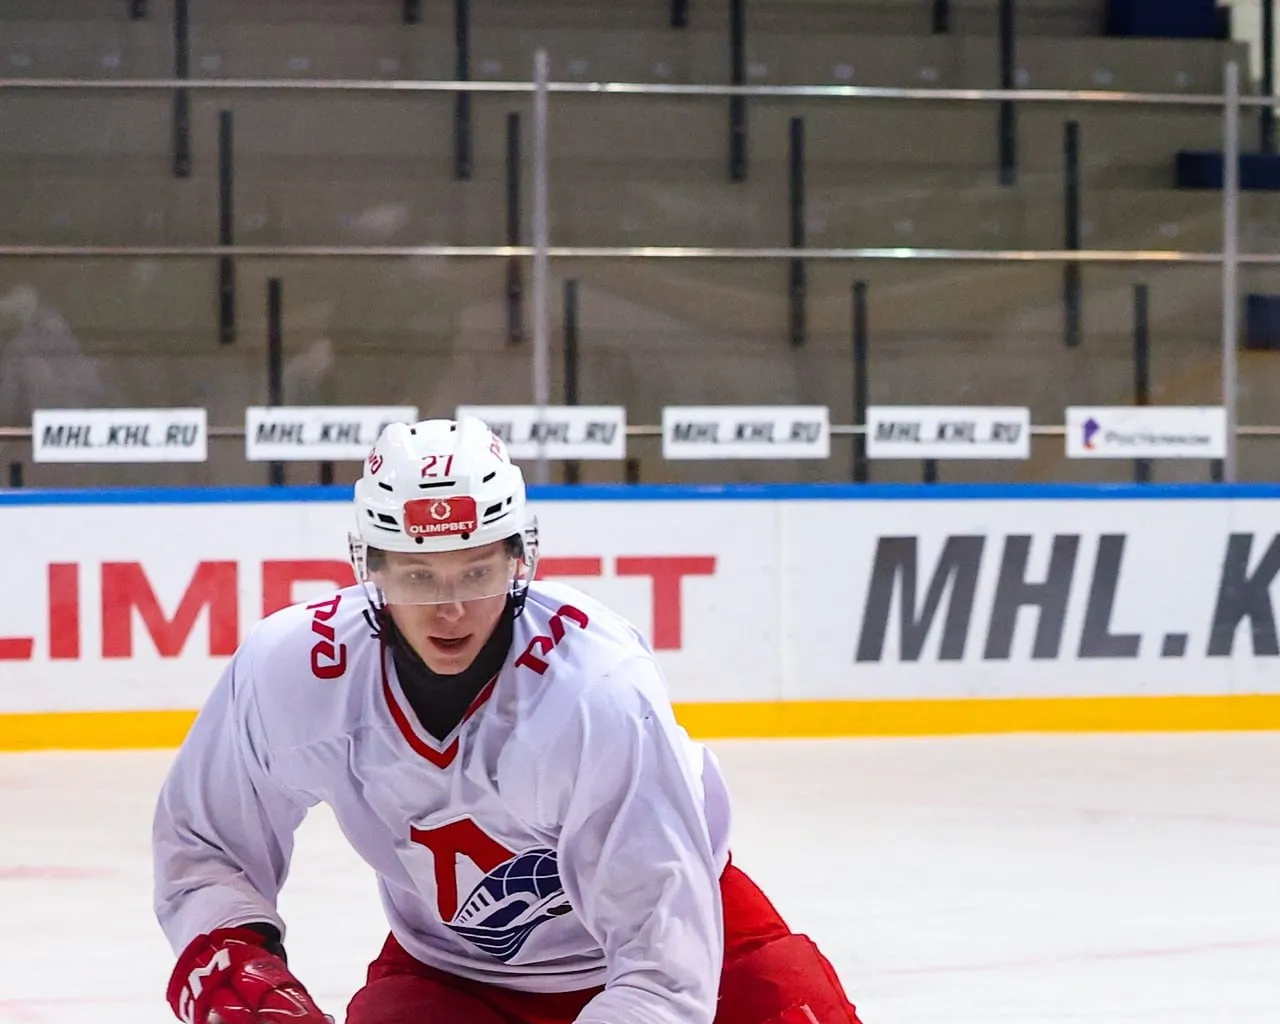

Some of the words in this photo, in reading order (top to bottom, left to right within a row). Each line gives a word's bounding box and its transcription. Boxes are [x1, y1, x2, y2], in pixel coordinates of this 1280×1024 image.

[42, 424, 198, 447] MHL.KHL.RU
[255, 421, 393, 445] MHL.KHL.
[421, 454, 454, 478] 27
[409, 520, 475, 535] OLIMPBET
